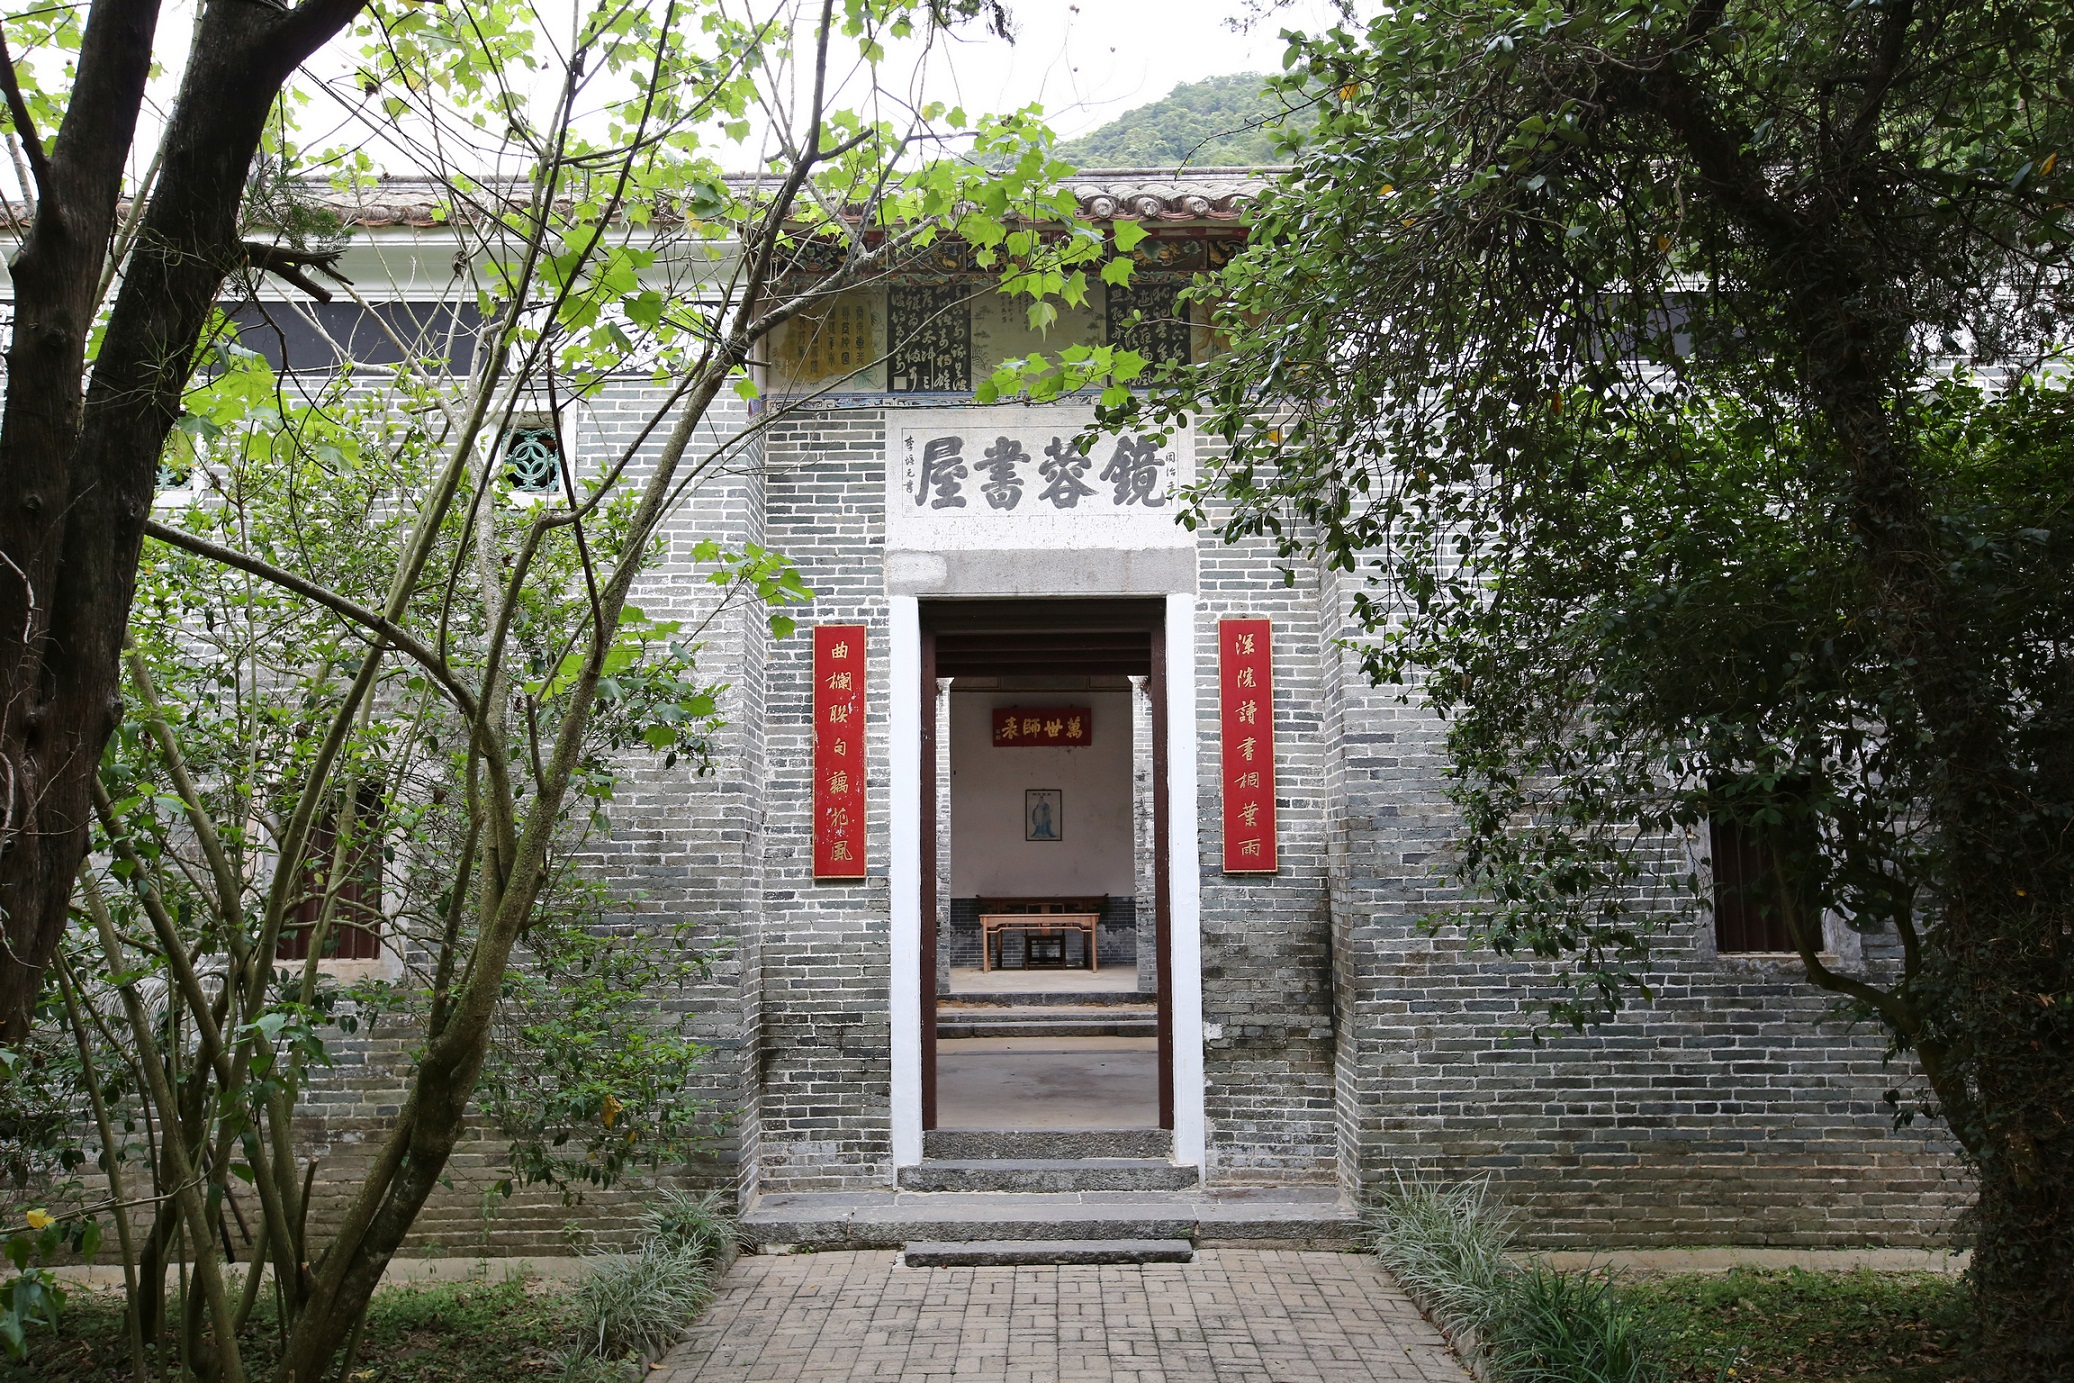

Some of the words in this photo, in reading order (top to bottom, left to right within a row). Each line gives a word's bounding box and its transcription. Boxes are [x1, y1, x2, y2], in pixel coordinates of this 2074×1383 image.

[914, 434, 1167, 510] 鏡蓉書屋
[1001, 715, 1083, 739] 萬世師表
